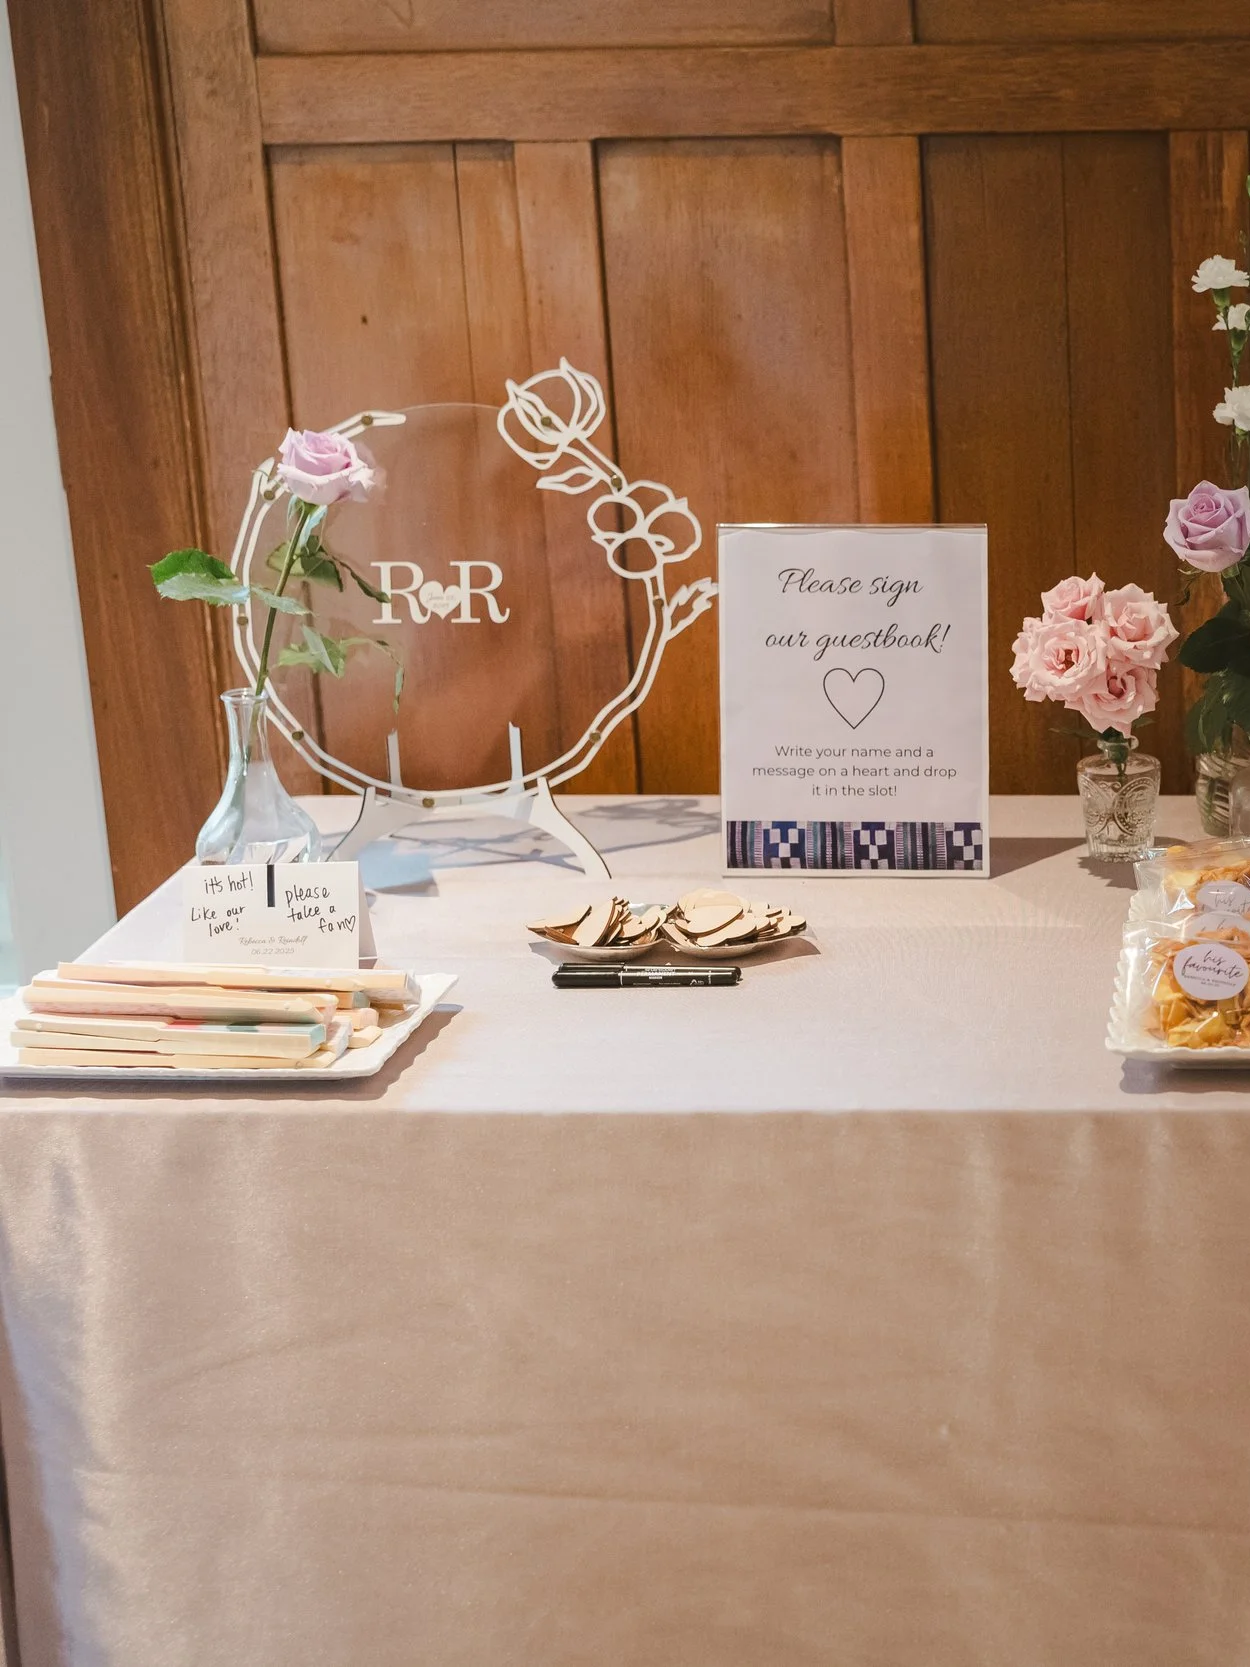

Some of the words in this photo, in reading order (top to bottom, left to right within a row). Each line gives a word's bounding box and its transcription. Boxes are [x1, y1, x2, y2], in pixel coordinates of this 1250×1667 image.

[370, 561, 432, 624] R
[450, 561, 510, 624] R
[778, 568, 863, 595] Please
[869, 575, 923, 607] sign
[765, 629, 809, 648] our
[813, 623, 951, 661] guestbook!
[775, 745, 812, 758] Write
[815, 747, 847, 760] your
[851, 747, 891, 758] name
[895, 746, 922, 758] and
[926, 748, 934, 758] a
[752, 766, 815, 779] message
[818, 768, 837, 777] on
[840, 769, 848, 778] a
[852, 765, 889, 778] heart
[893, 766, 920, 778] and
[923, 766, 957, 781] drop
[812, 785, 821, 797] it
[825, 785, 837, 797] in
[842, 785, 864, 797] the
[868, 784, 897, 797] slot!
[228, 871, 253, 892] hot!
[285, 885, 331, 907] please
[191, 907, 217, 921] Like
[226, 905, 246, 917] our
[287, 907, 320, 922] take
[329, 905, 336, 913] a
[209, 918, 239, 937] love!
[317, 917, 345, 933] fan
[1203, 950, 1225, 966] his
[1182, 956, 1244, 980] favourite
